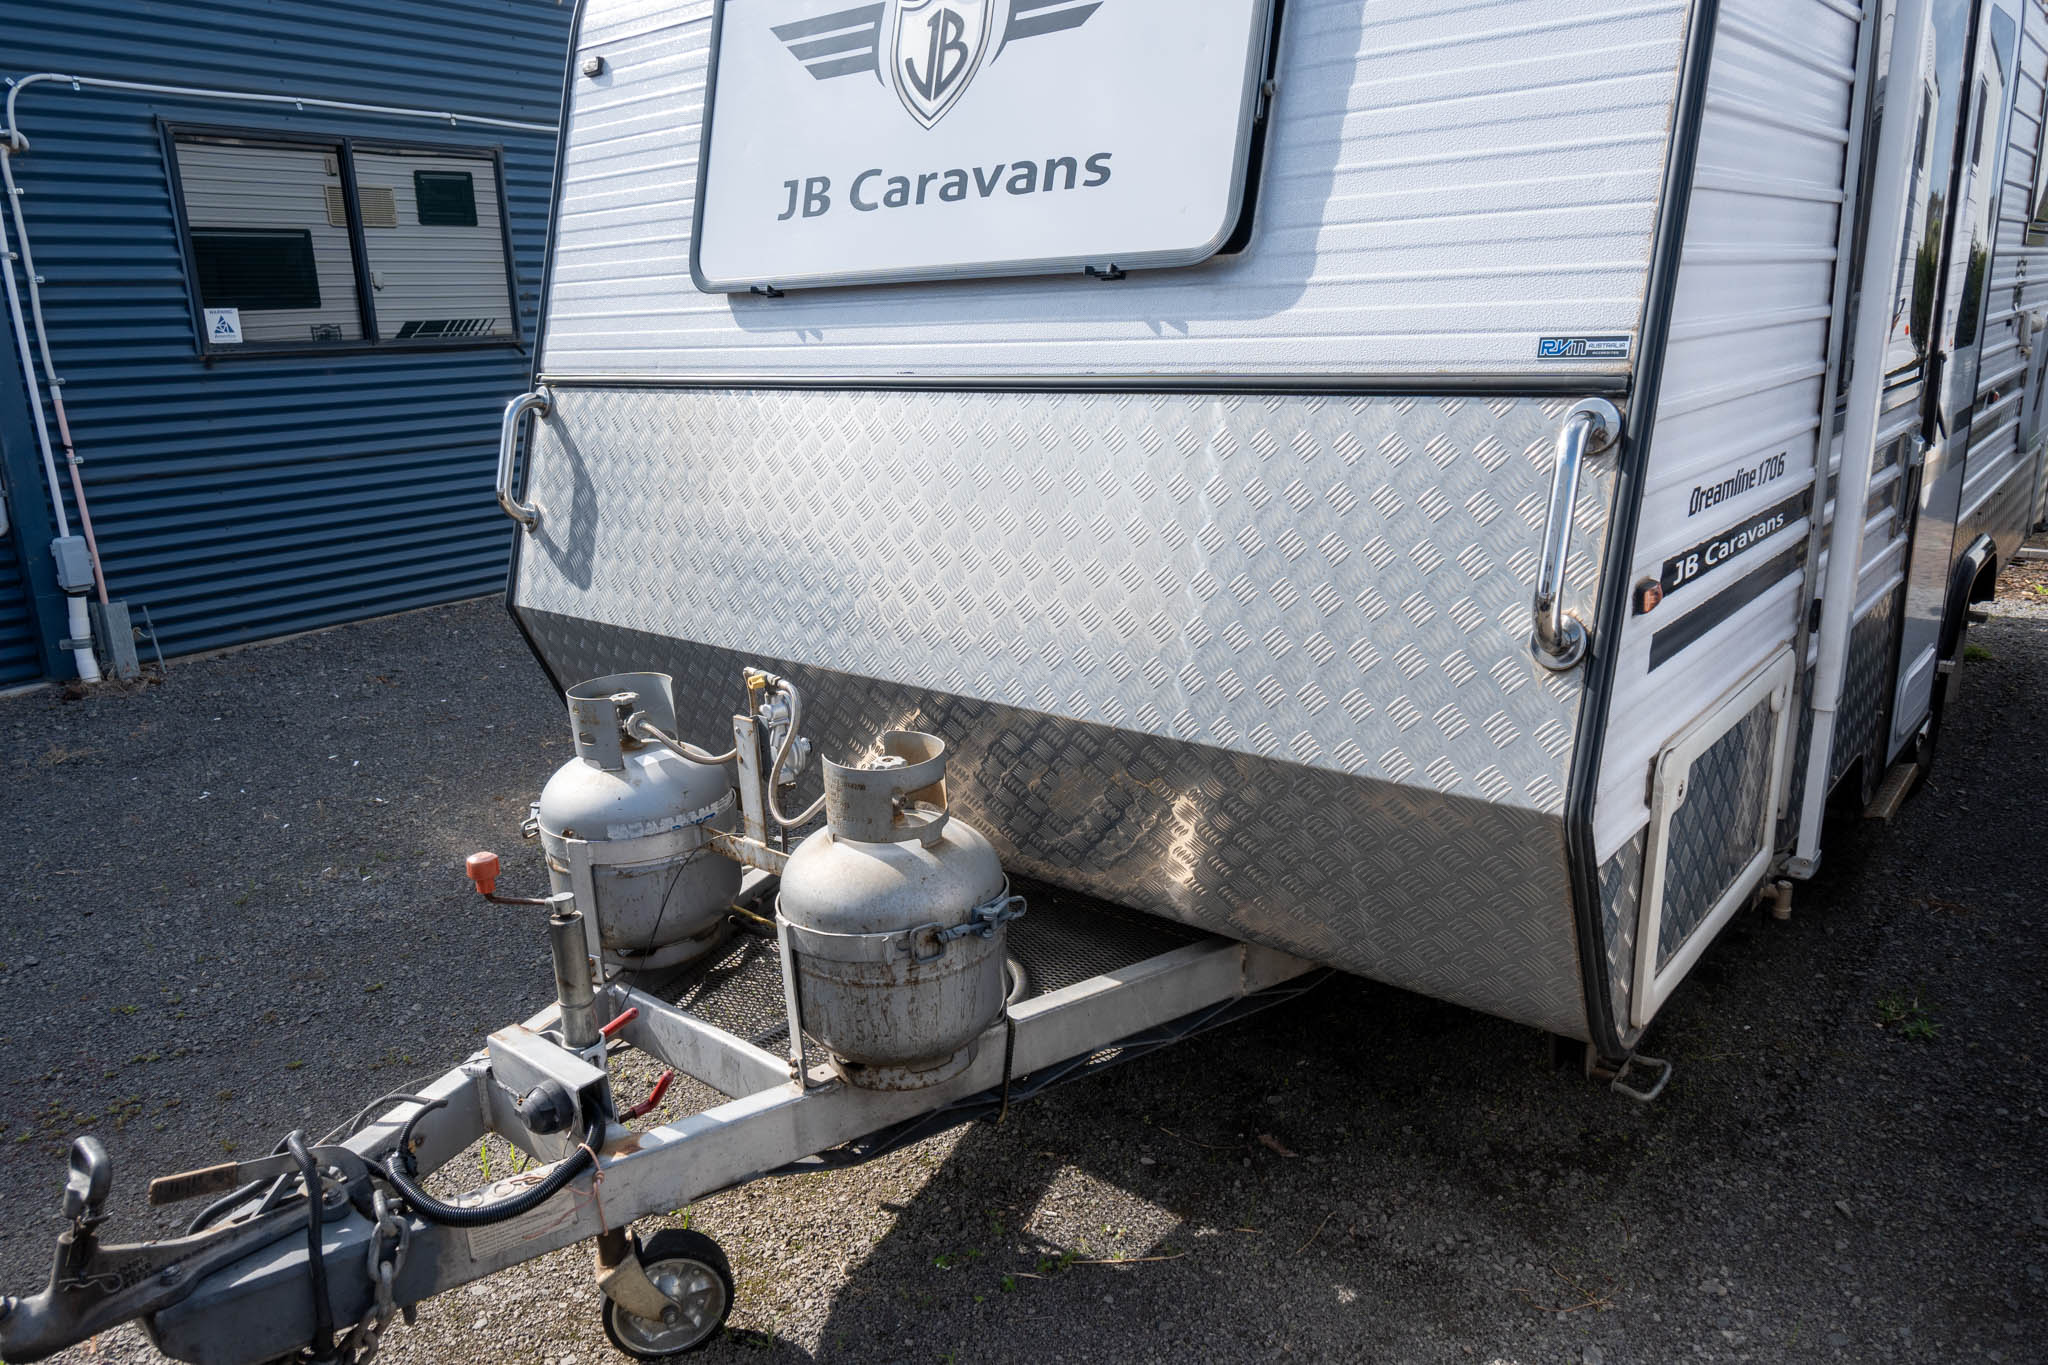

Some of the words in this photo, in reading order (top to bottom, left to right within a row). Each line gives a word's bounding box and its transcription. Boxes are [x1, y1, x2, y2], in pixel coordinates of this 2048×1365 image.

[904, 7, 968, 102] JB
[777, 176, 832, 221] JB
[849, 151, 1112, 212] Caravans
[1687, 467, 1756, 518] Dreamline
[1757, 451, 1787, 487] 1706
[1672, 553, 1699, 586] JB
[1704, 512, 1784, 566] Caravans
